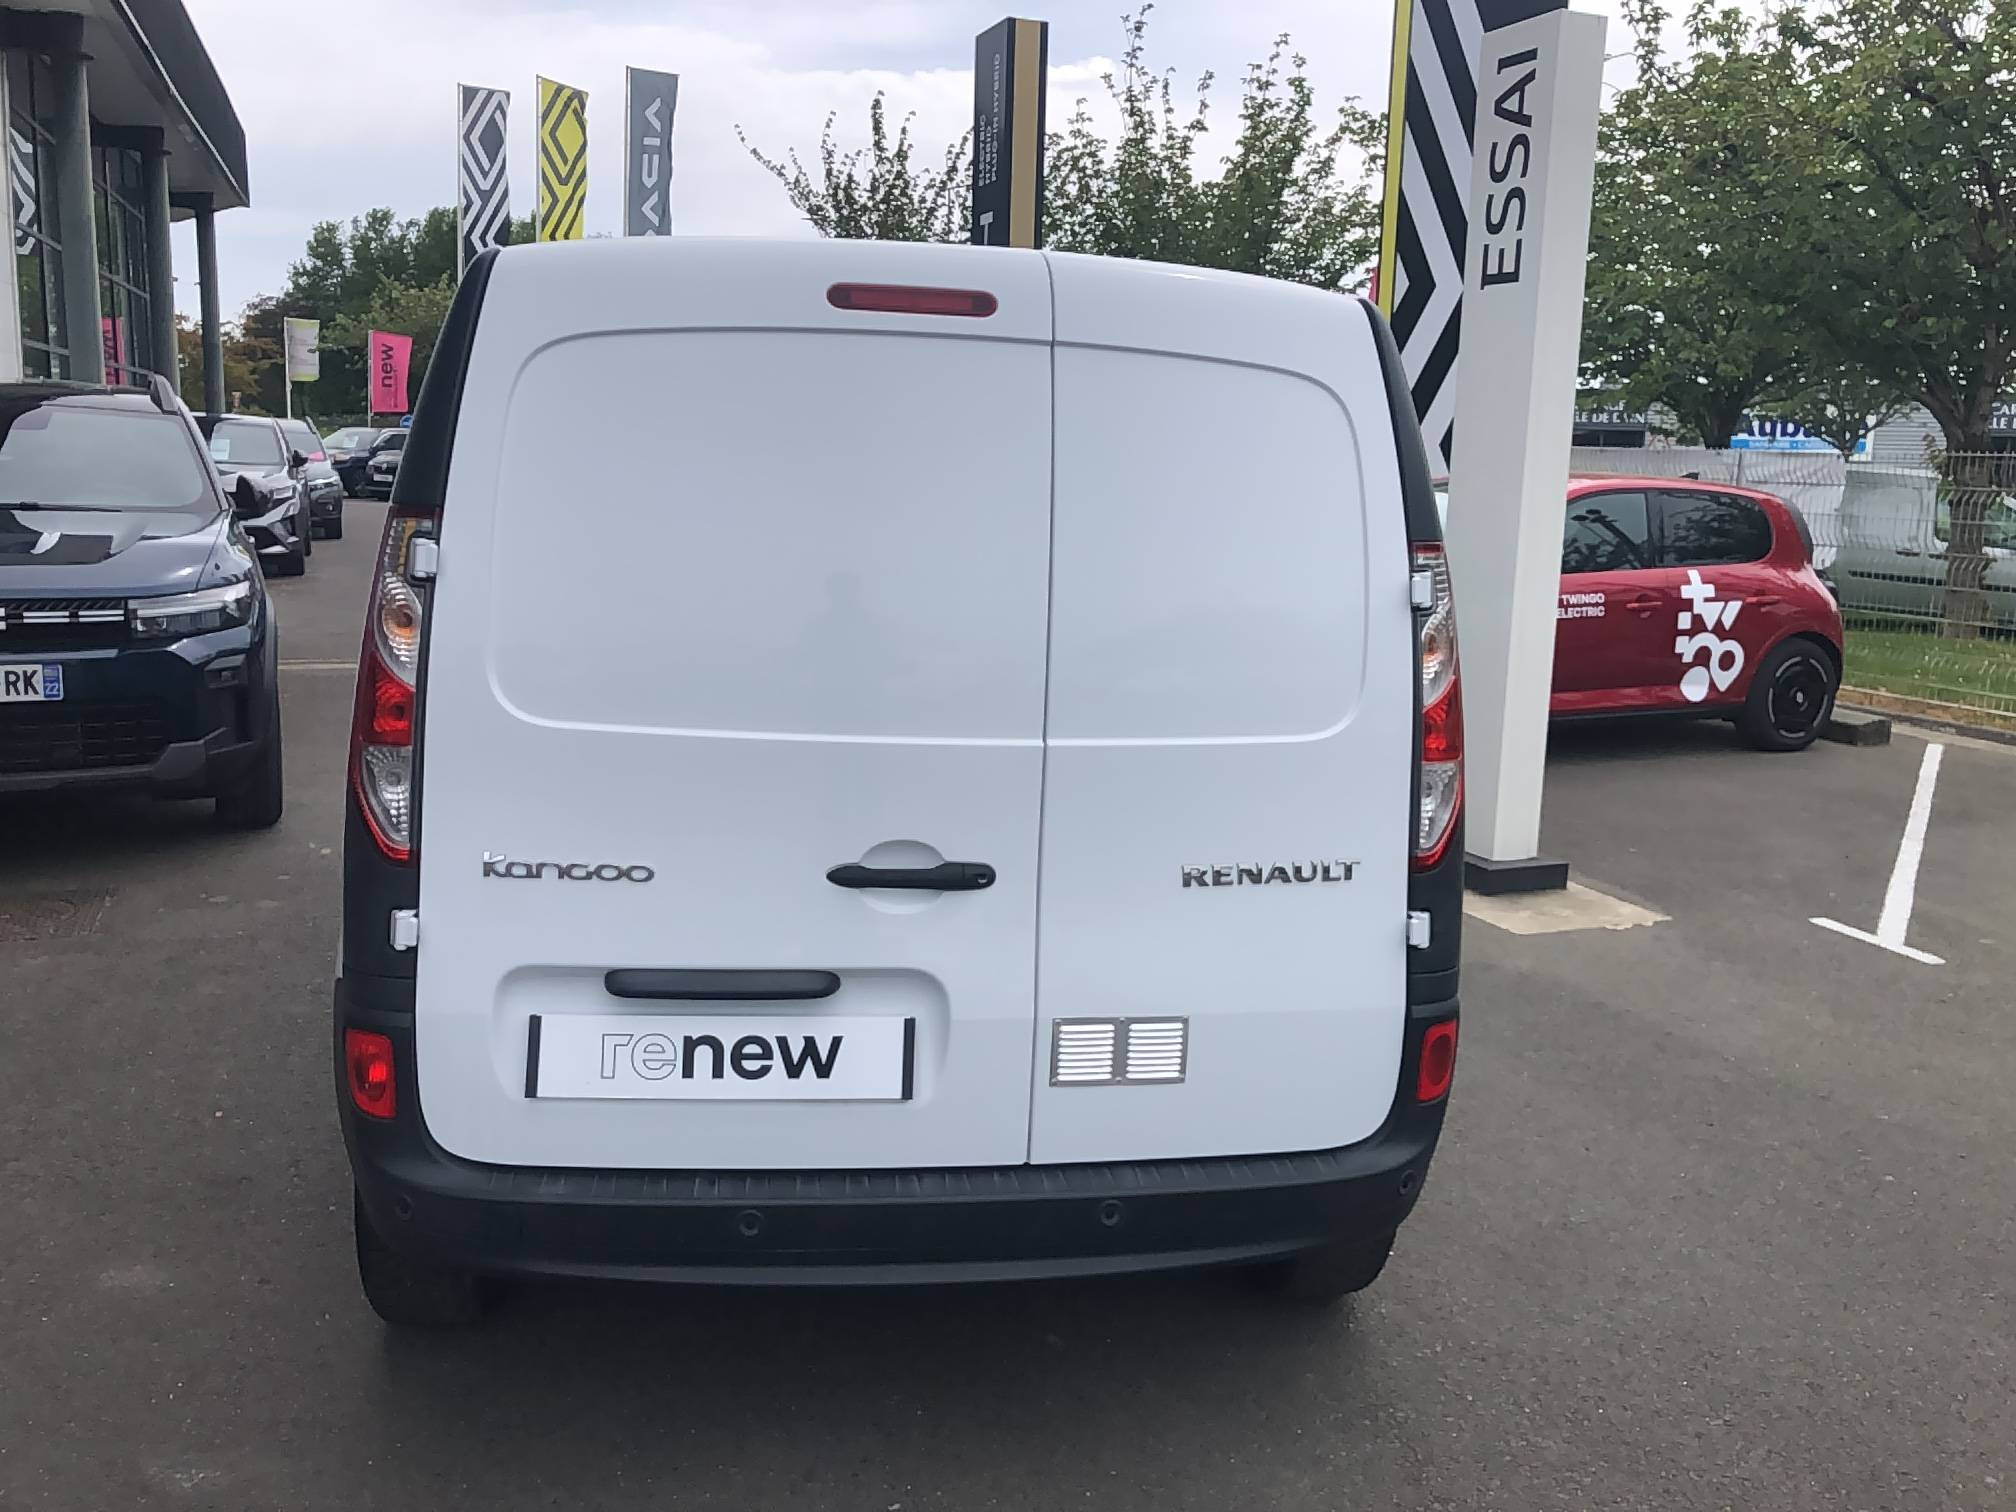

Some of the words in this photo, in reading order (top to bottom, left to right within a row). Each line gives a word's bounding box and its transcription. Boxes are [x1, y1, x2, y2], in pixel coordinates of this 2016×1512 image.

[640, 97, 662, 236] ACIA
[1480, 47, 1539, 290] ESSAI
[381, 343, 395, 388] new
[1562, 593, 1605, 605] TWINGO
[4, 670, 40, 696] RK
[482, 851, 655, 883] Kangoo
[1181, 859, 1361, 888] RENAULT
[600, 1033, 844, 1080] renew
